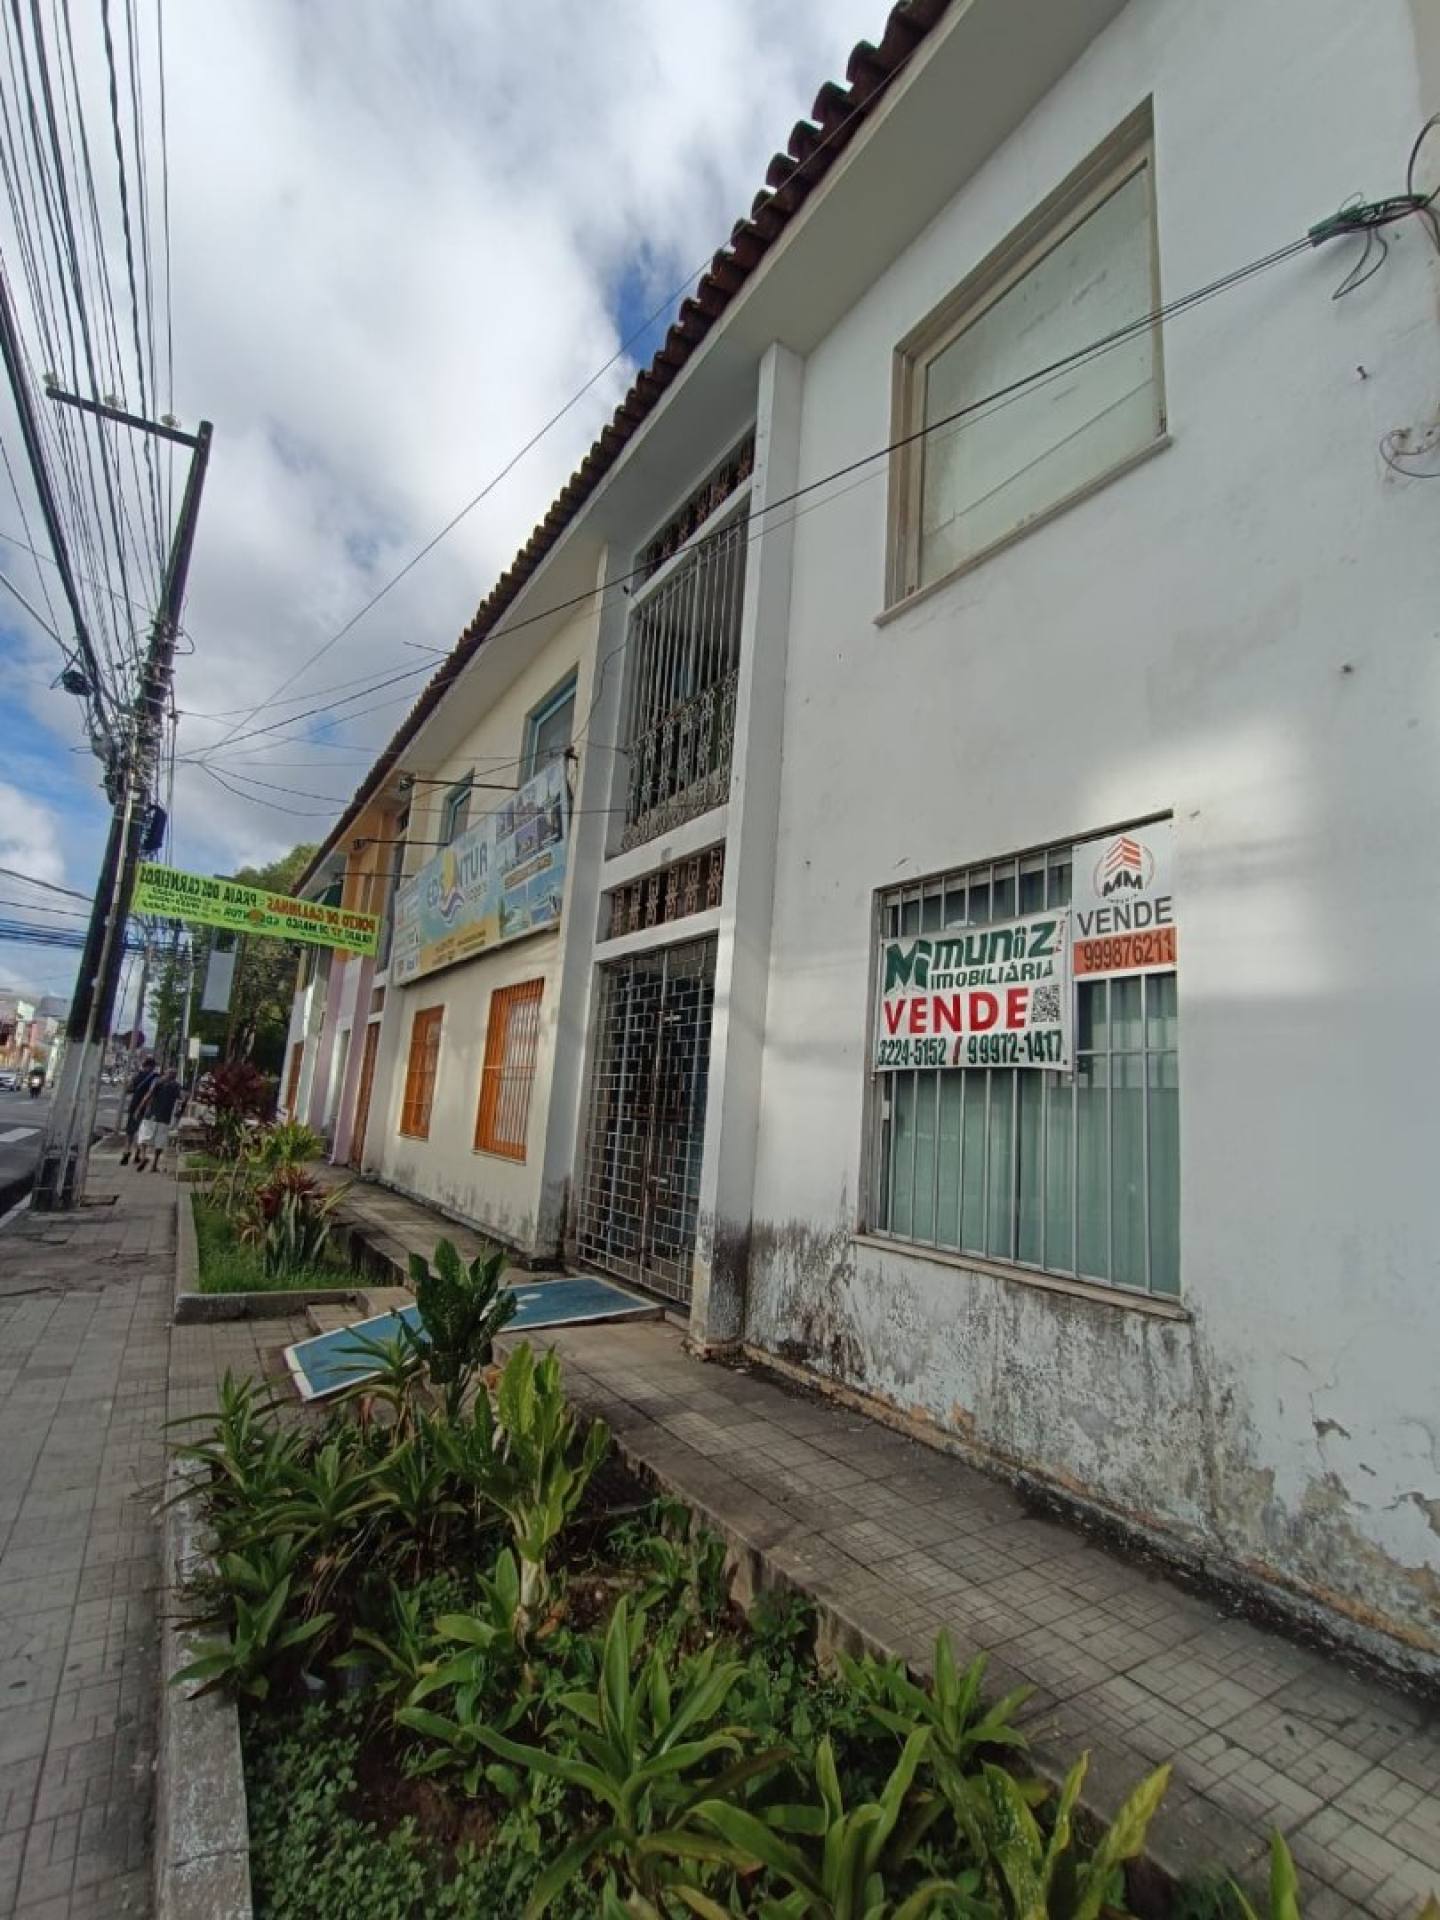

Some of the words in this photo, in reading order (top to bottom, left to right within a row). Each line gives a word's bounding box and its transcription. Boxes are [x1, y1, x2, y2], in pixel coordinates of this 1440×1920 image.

[1077, 895, 1173, 936] VENDE
[930, 959, 1053, 990] IMOBILIÁRIA
[884, 987, 1029, 1036] VENDE
[967, 1029, 1063, 1066] 99972-1417
